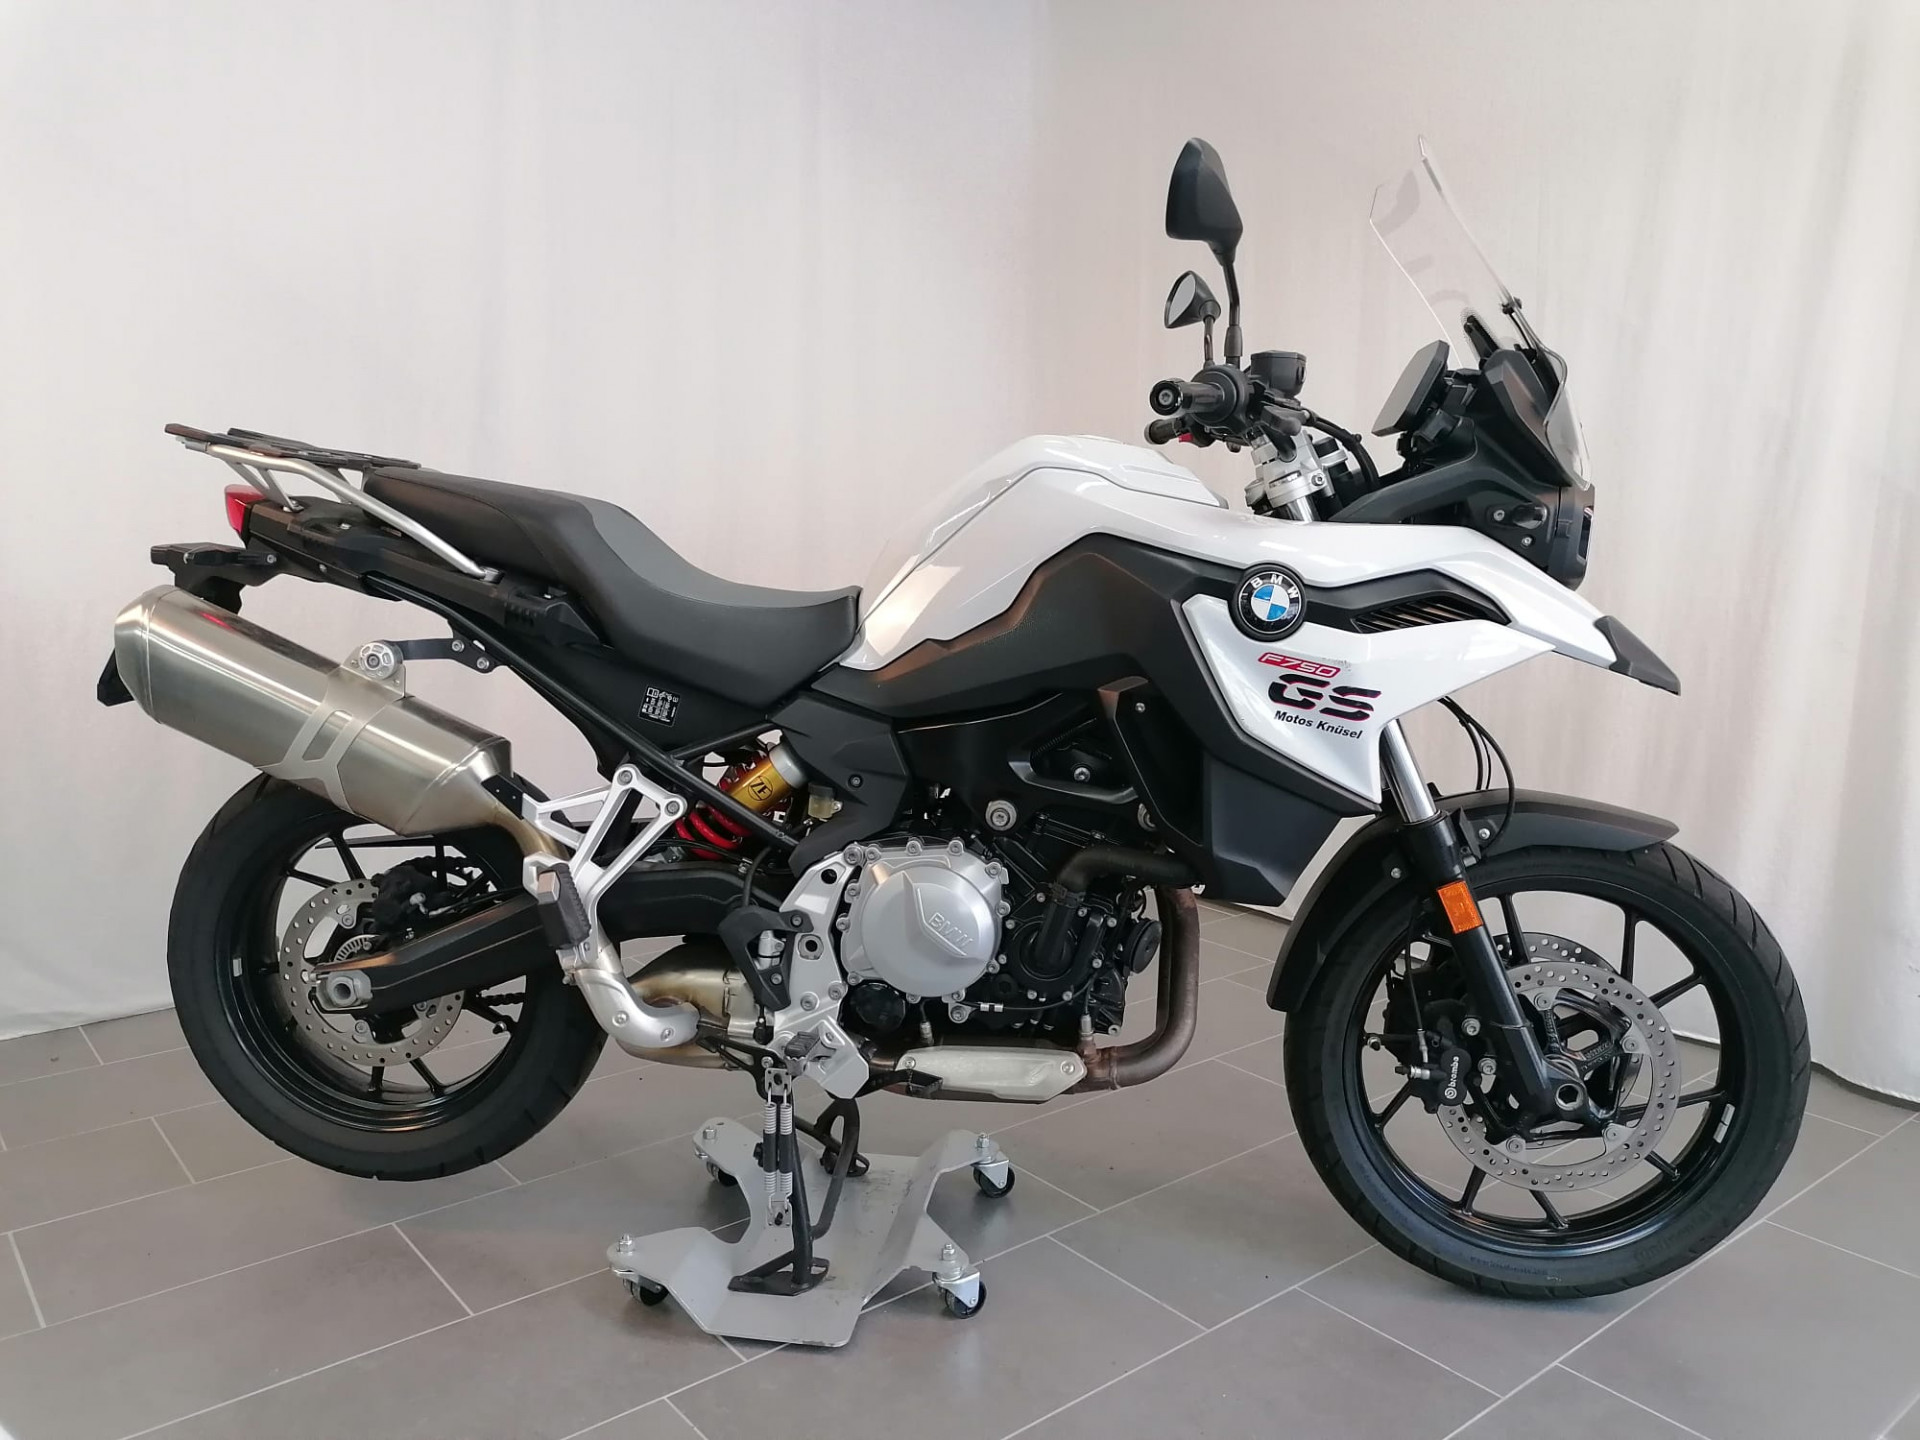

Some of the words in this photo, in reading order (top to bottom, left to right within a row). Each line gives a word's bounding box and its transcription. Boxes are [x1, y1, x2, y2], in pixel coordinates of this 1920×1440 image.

[1250, 573, 1300, 599] BMW
[1261, 653, 1337, 677] F750
[1268, 673, 1382, 722] GS
[1273, 710, 1313, 728] Motos
[1316, 720, 1363, 739] Knüsel
[928, 912, 974, 947] BMW
[1448, 1056, 1460, 1088] brembo
